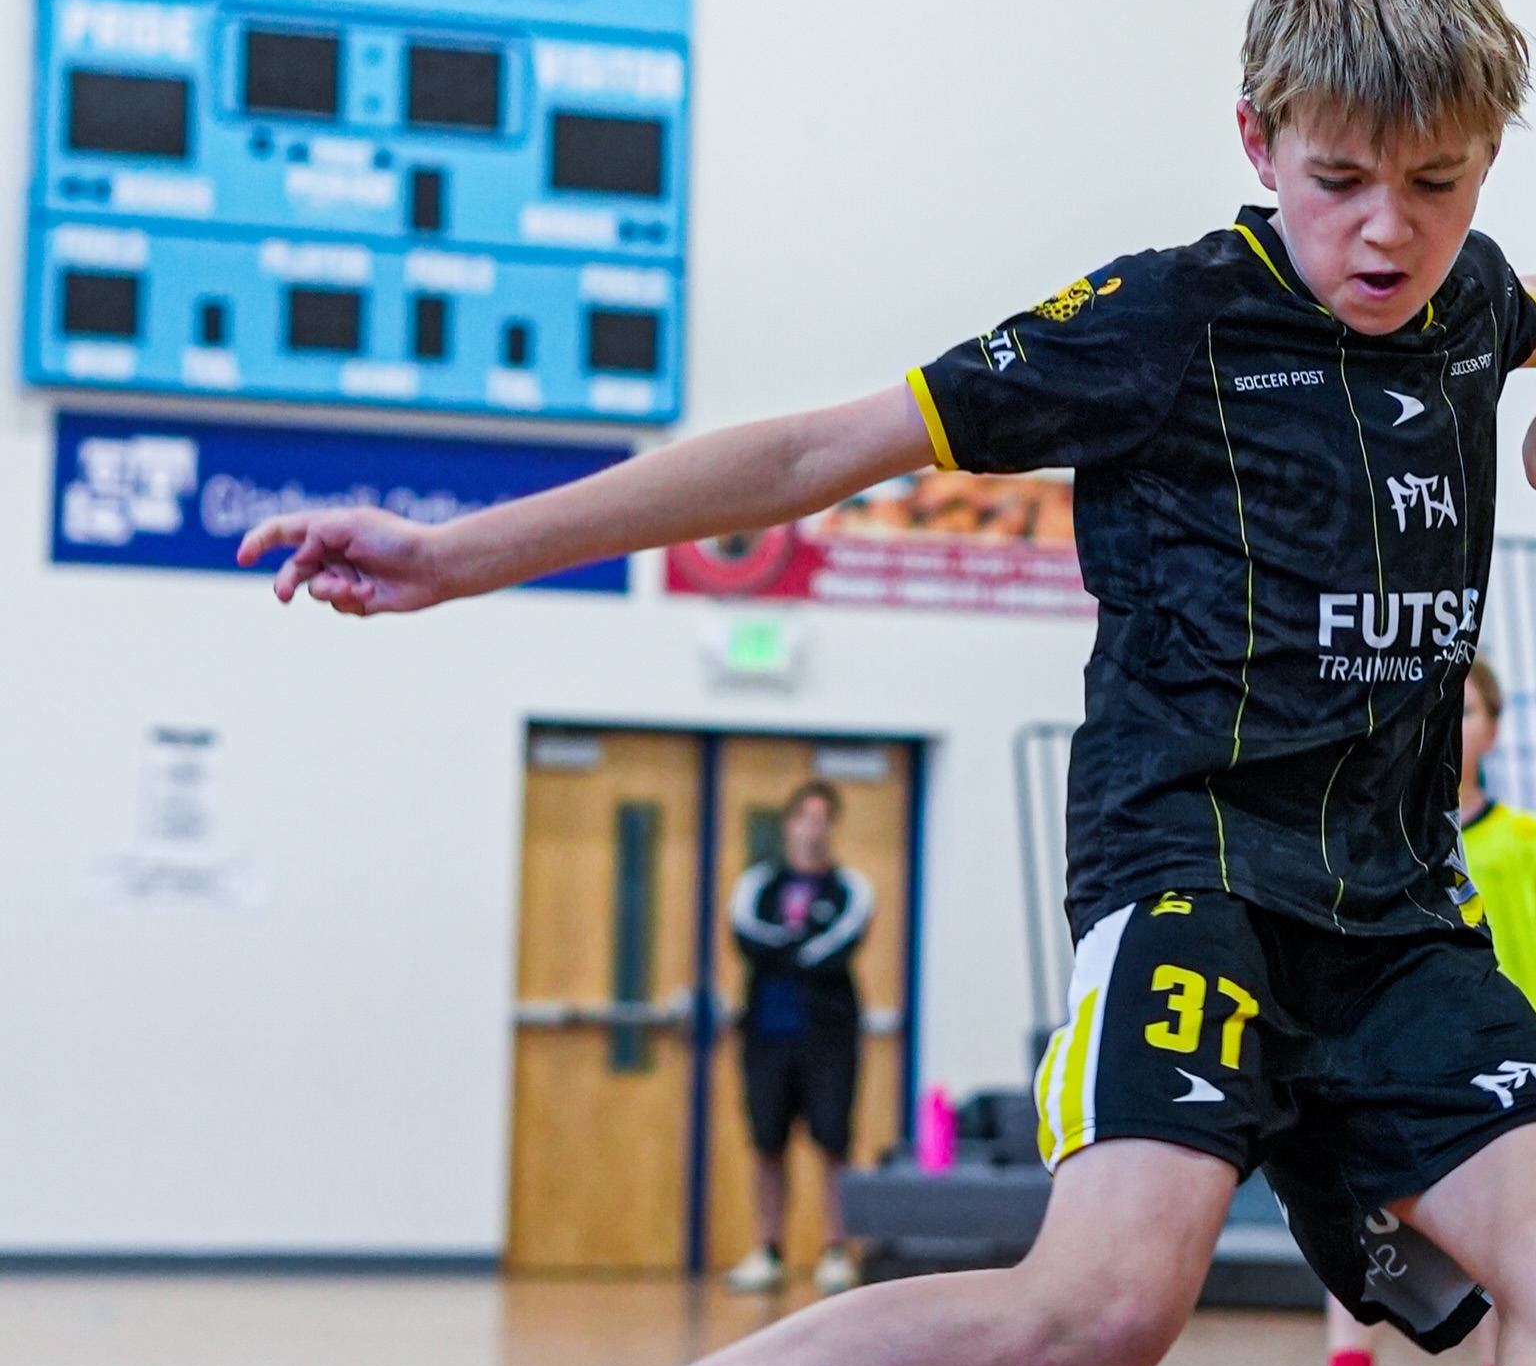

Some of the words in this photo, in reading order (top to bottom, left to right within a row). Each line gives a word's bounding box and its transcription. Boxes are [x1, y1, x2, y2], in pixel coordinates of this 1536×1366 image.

[988, 329, 1017, 372] TA
[1450, 358, 1479, 377] SOCCER
[1234, 372, 1290, 392] SOCCER
[1291, 370, 1325, 387] POST
[1318, 588, 1480, 650] FUTS
[1318, 654, 1424, 683] TRAINING
[1144, 963, 1260, 1070] 37
